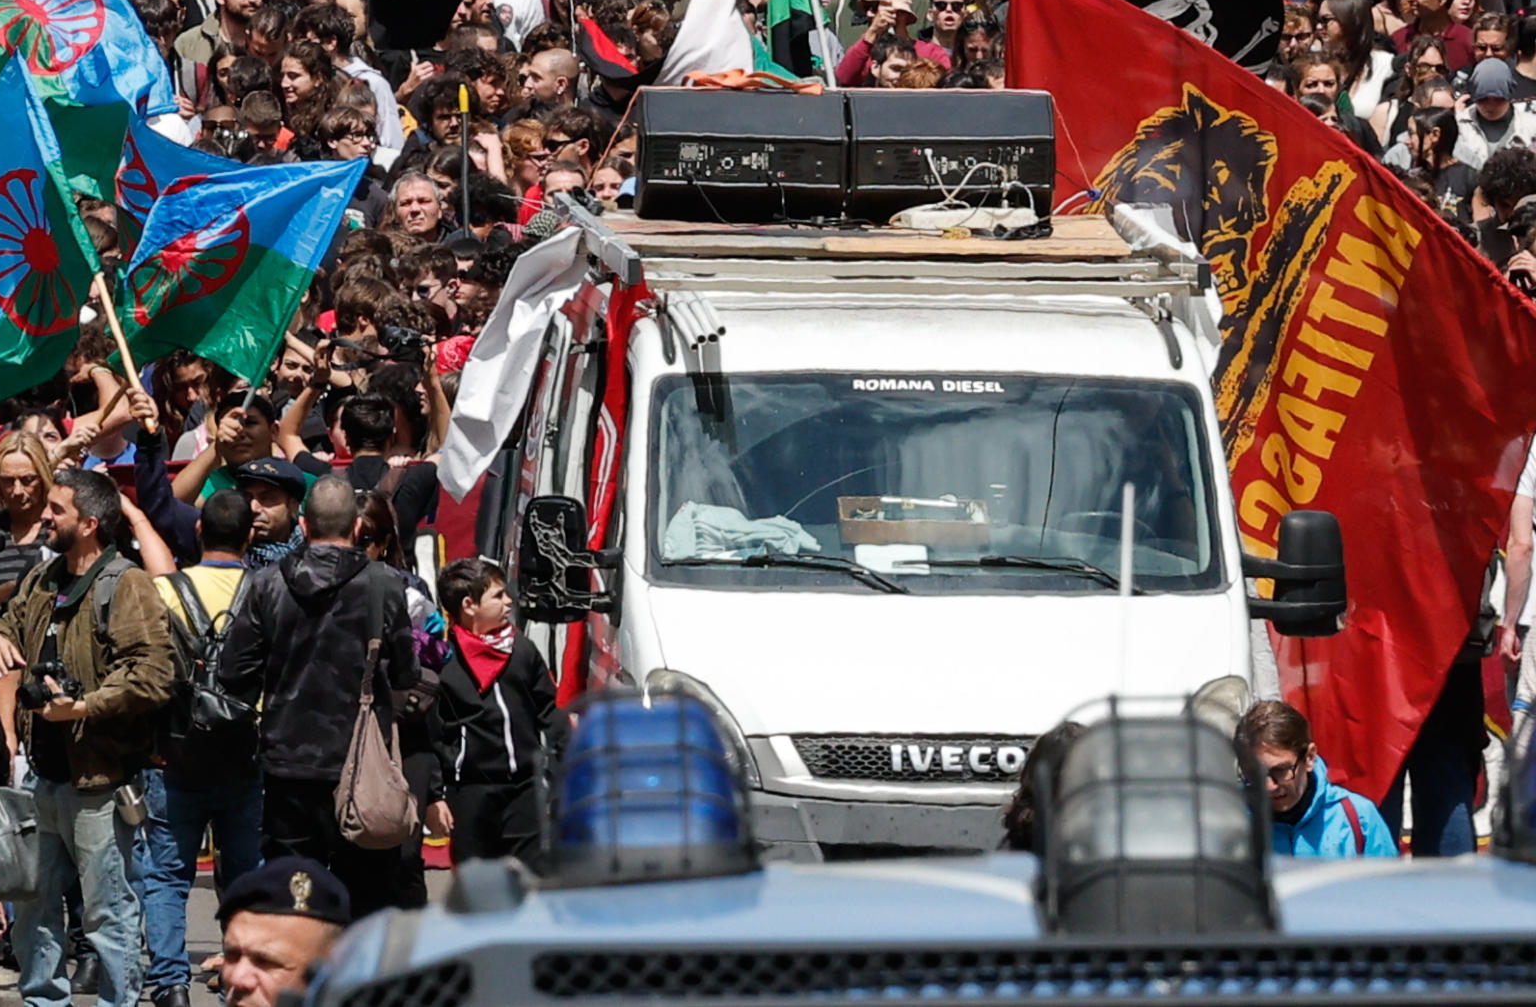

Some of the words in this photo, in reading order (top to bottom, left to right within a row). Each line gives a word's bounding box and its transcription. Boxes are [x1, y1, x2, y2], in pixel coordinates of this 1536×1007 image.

[852, 378, 936, 392] ROMANA
[941, 379, 1005, 393] DIESEL
[890, 743, 1026, 774] IVECO
